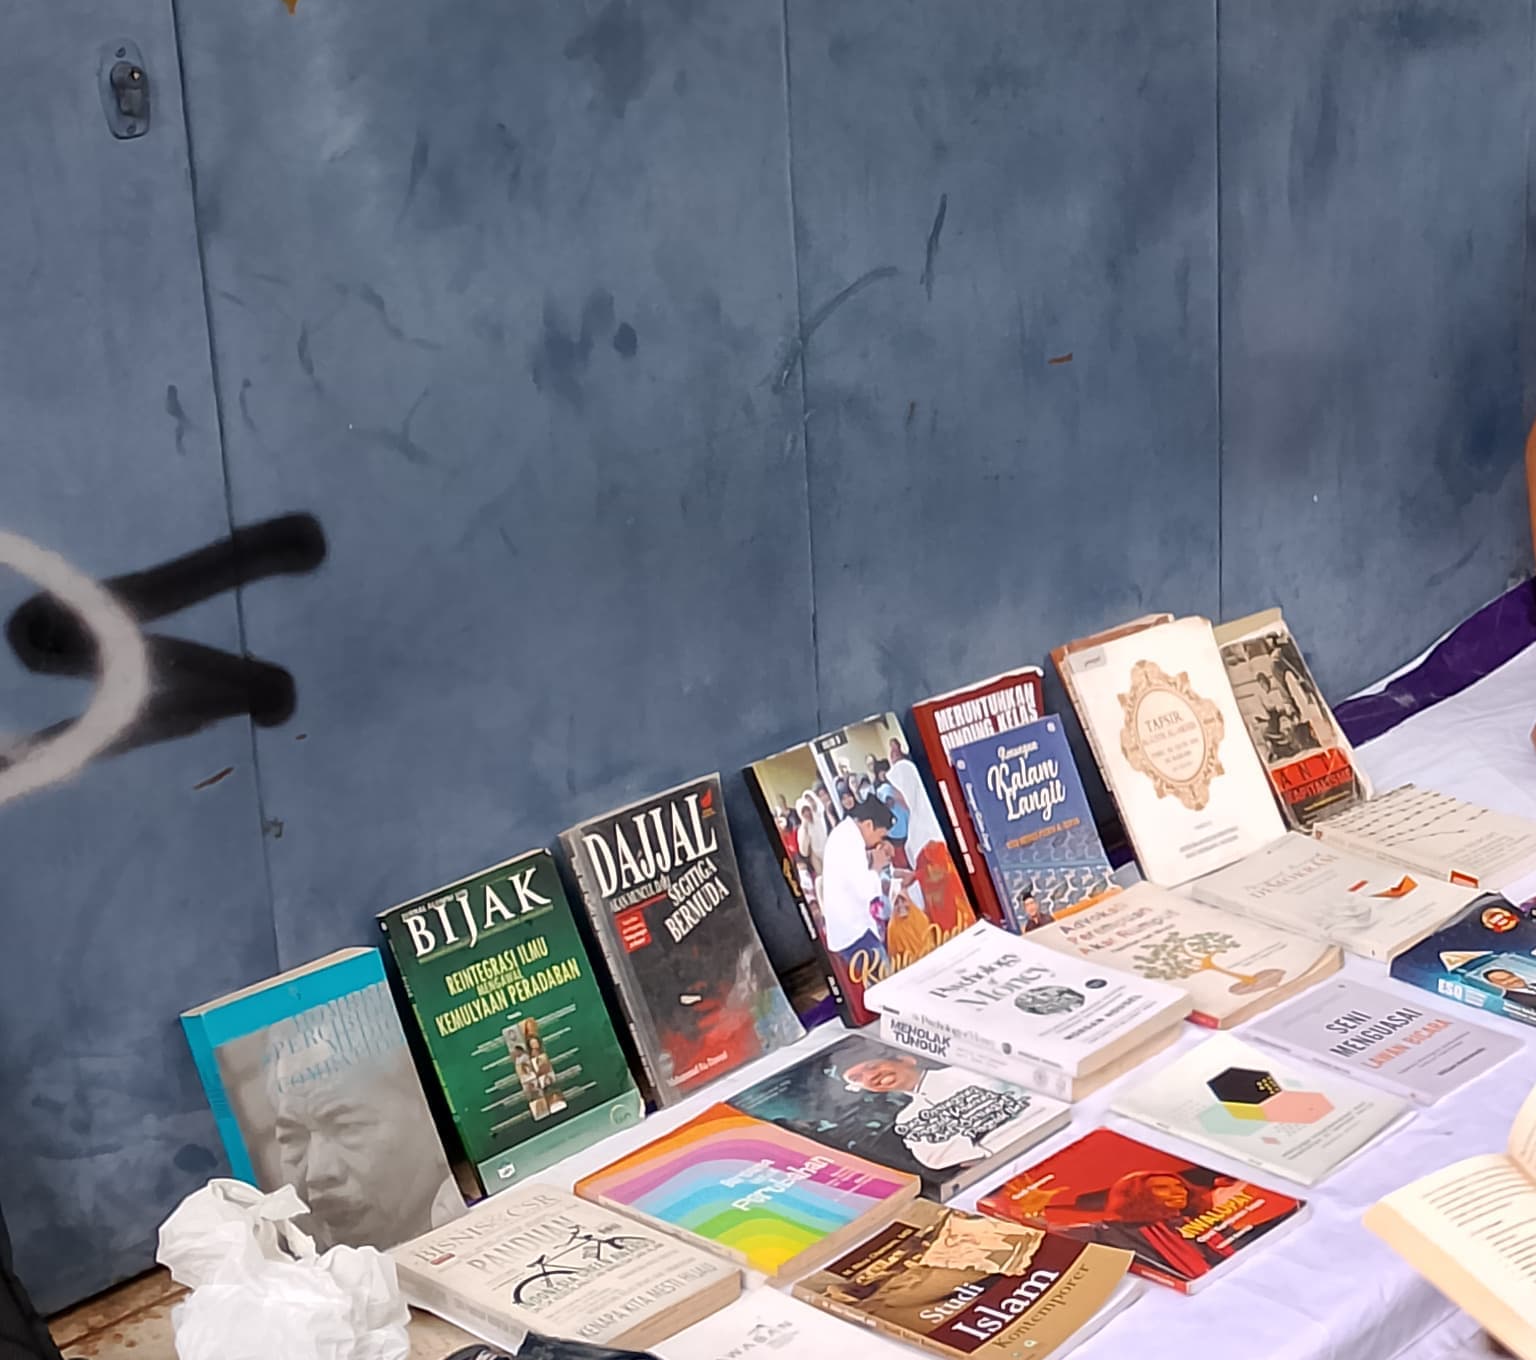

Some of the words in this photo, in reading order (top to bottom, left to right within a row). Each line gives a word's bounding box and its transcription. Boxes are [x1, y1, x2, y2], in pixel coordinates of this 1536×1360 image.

[987, 757, 1059, 800] Kalam
[1004, 780, 1067, 821] Langit
[582, 794, 719, 898] DAJJAL
[664, 877, 730, 943] BERMUDA
[667, 857, 718, 907] SEGITIGA
[403, 867, 552, 958] BIJAK
[445, 949, 517, 996] REINTEGRASI
[516, 936, 549, 966] ILMU
[435, 991, 509, 1037] KEMULYAAN
[508, 958, 582, 1006] PERADABAN
[1325, 1010, 1373, 1034] SENI
[889, 1018, 951, 1047] MENOLAK
[892, 1031, 948, 1058] TUNDUK
[1329, 1007, 1423, 1058] MENGUASAI
[466, 1215, 575, 1273] PANDUAN
[576, 1307, 626, 1340] KENAPA
[624, 1293, 650, 1316] KITA
[647, 1276, 682, 1304] MESTI
[919, 1282, 985, 1324] Studi
[952, 1267, 1060, 1340] Islam
[992, 1264, 1091, 1350] Kontemporer
